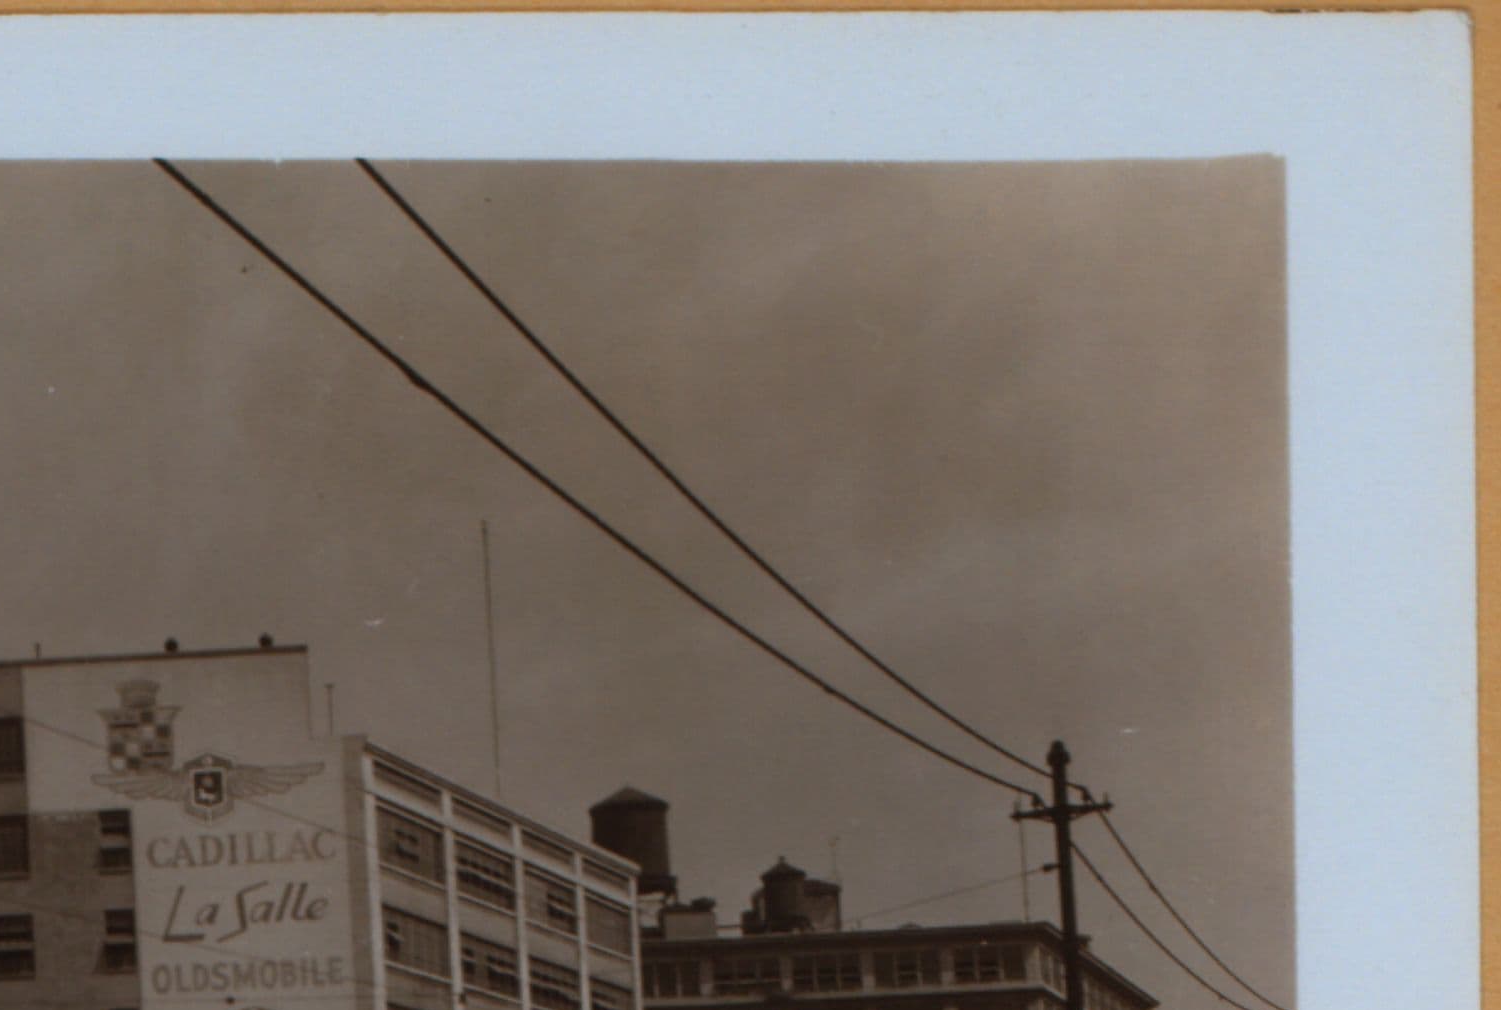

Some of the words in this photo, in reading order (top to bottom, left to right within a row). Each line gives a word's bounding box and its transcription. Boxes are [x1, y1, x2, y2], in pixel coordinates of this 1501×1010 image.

[147, 829, 337, 869] CADILLAC
[162, 885, 221, 942] La
[216, 880, 329, 942] Salle
[152, 956, 343, 994] OLDSMOBILE
